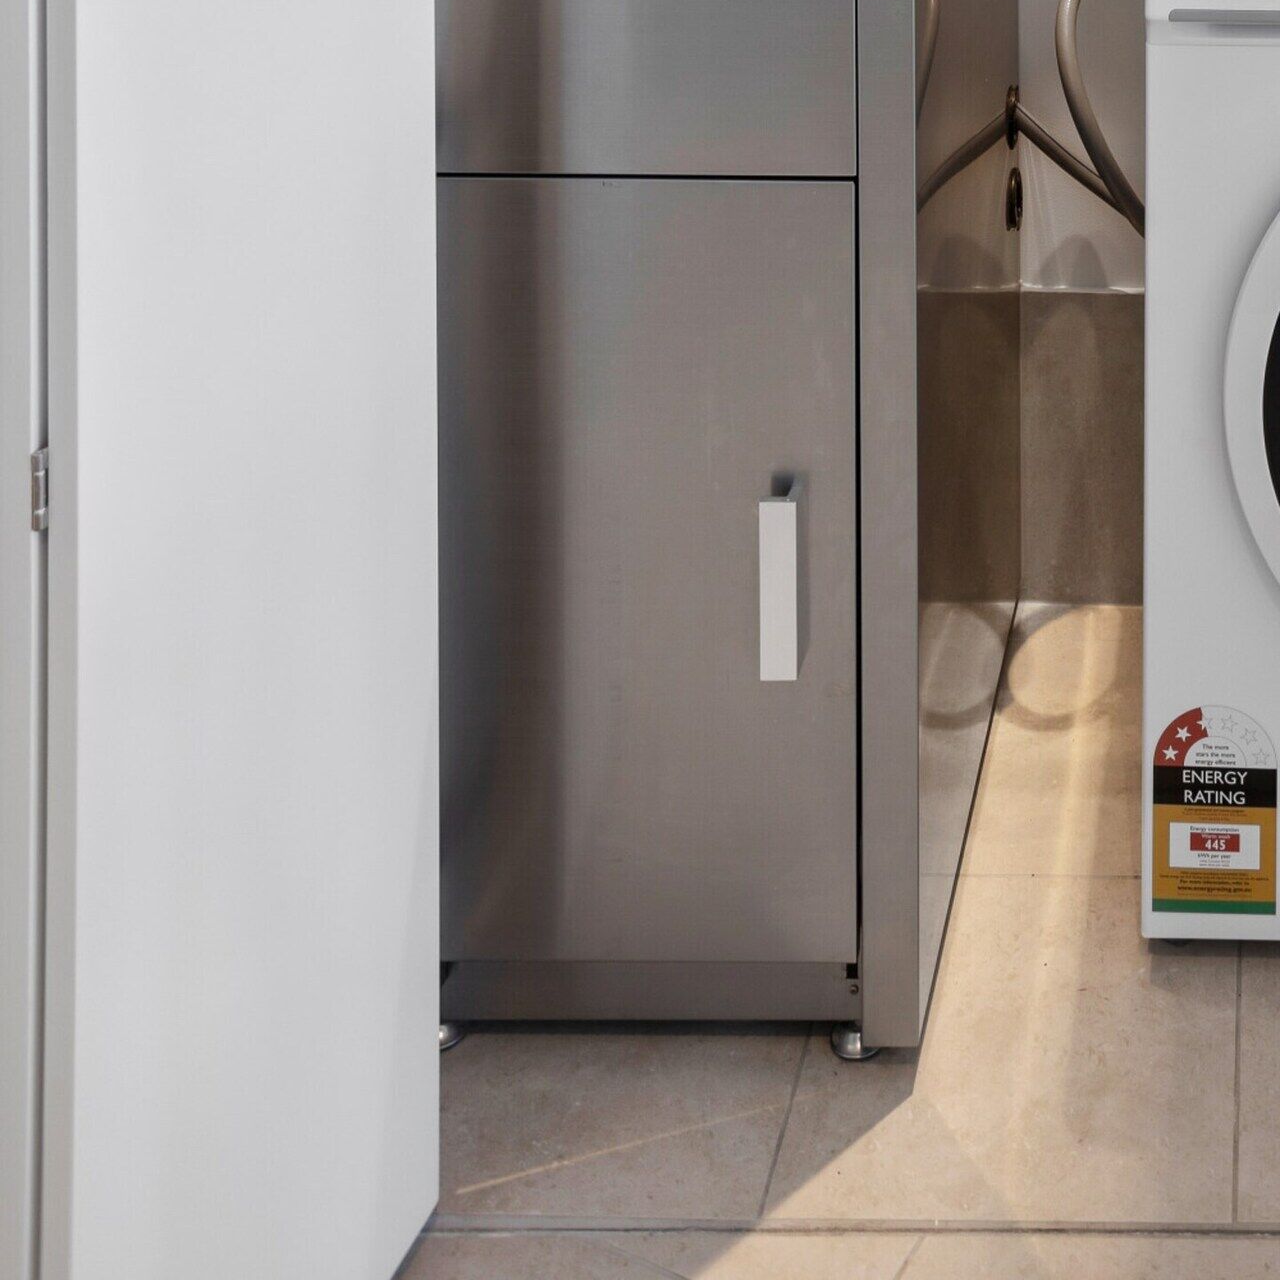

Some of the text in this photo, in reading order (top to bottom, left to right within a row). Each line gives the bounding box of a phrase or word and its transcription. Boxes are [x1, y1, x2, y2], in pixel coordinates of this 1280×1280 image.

[1182, 769, 1248, 785] ENERGY
[1183, 789, 1246, 805] RATING
[1205, 839, 1226, 850] 445
